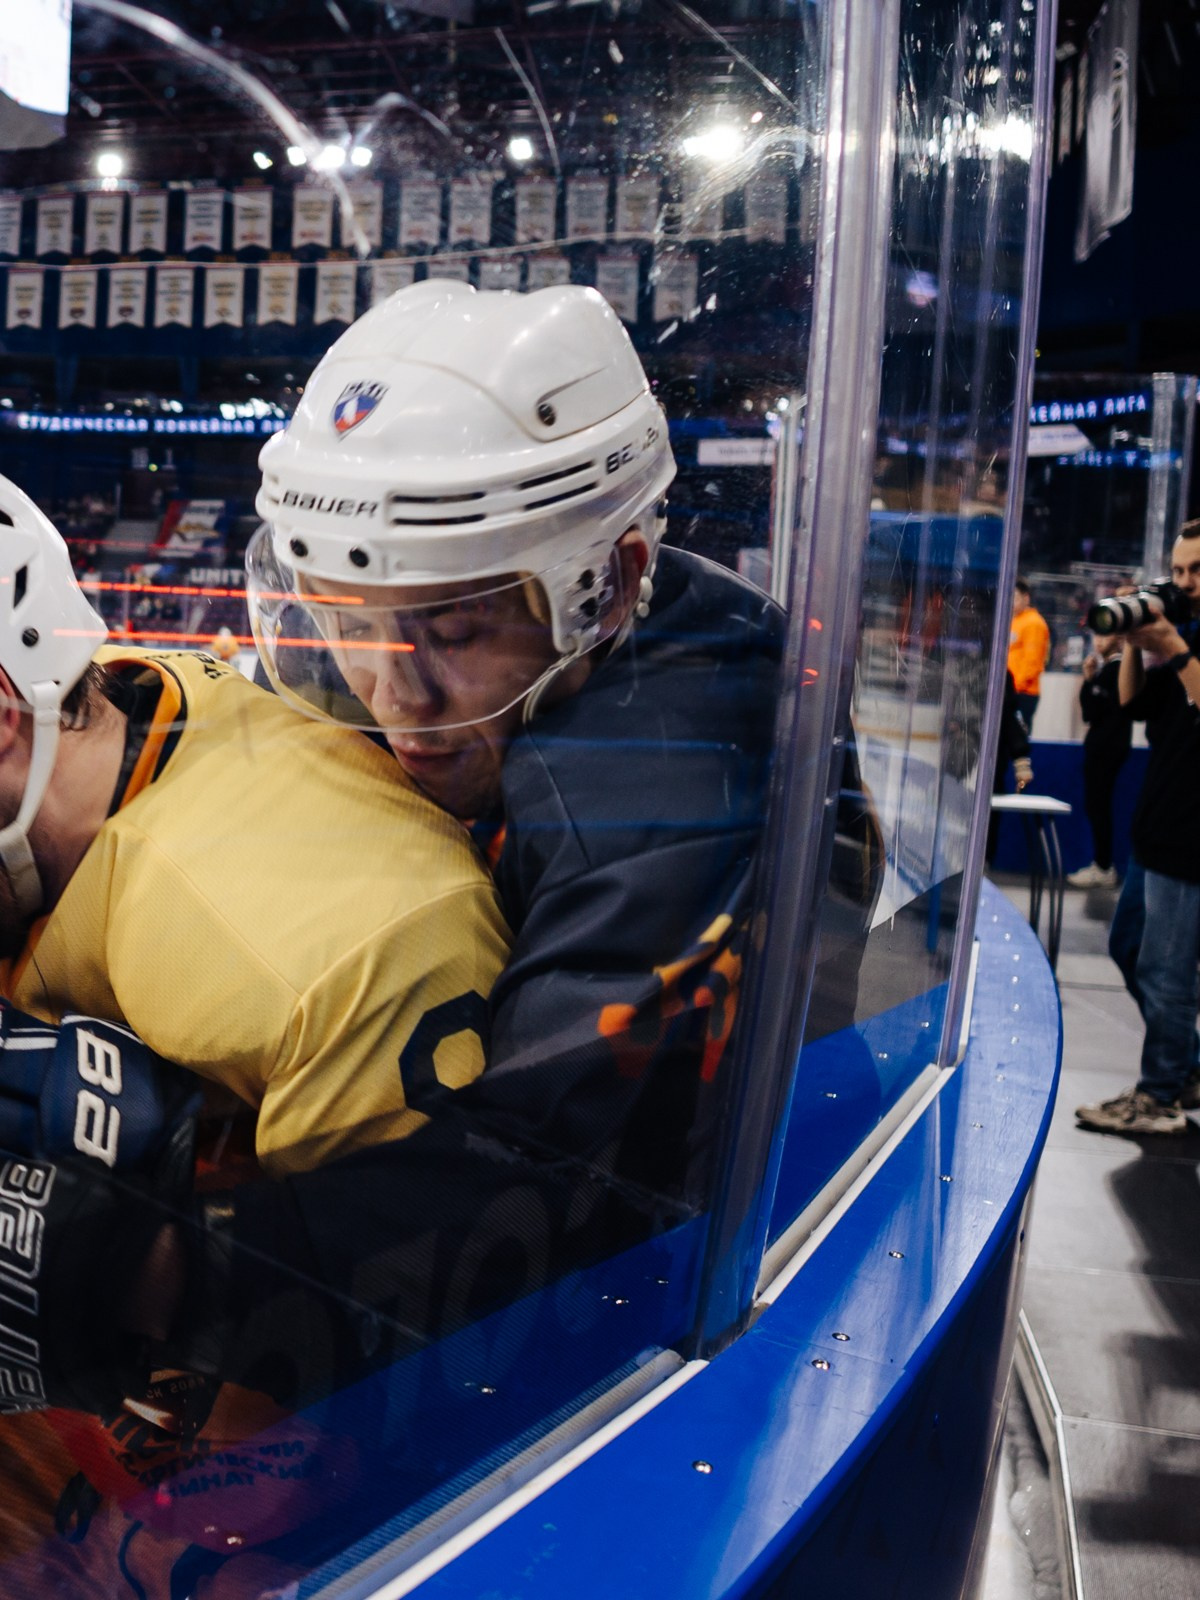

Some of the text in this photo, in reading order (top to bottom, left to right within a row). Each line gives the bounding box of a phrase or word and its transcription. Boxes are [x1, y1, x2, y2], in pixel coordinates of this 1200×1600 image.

[1104, 394, 1146, 416] ЛИГА
[17, 412, 149, 433] СТУДЕНЧЕСКАЯ
[154, 417, 255, 434] ХОККЕЙНАЯ
[283, 490, 379, 518] BAUER
